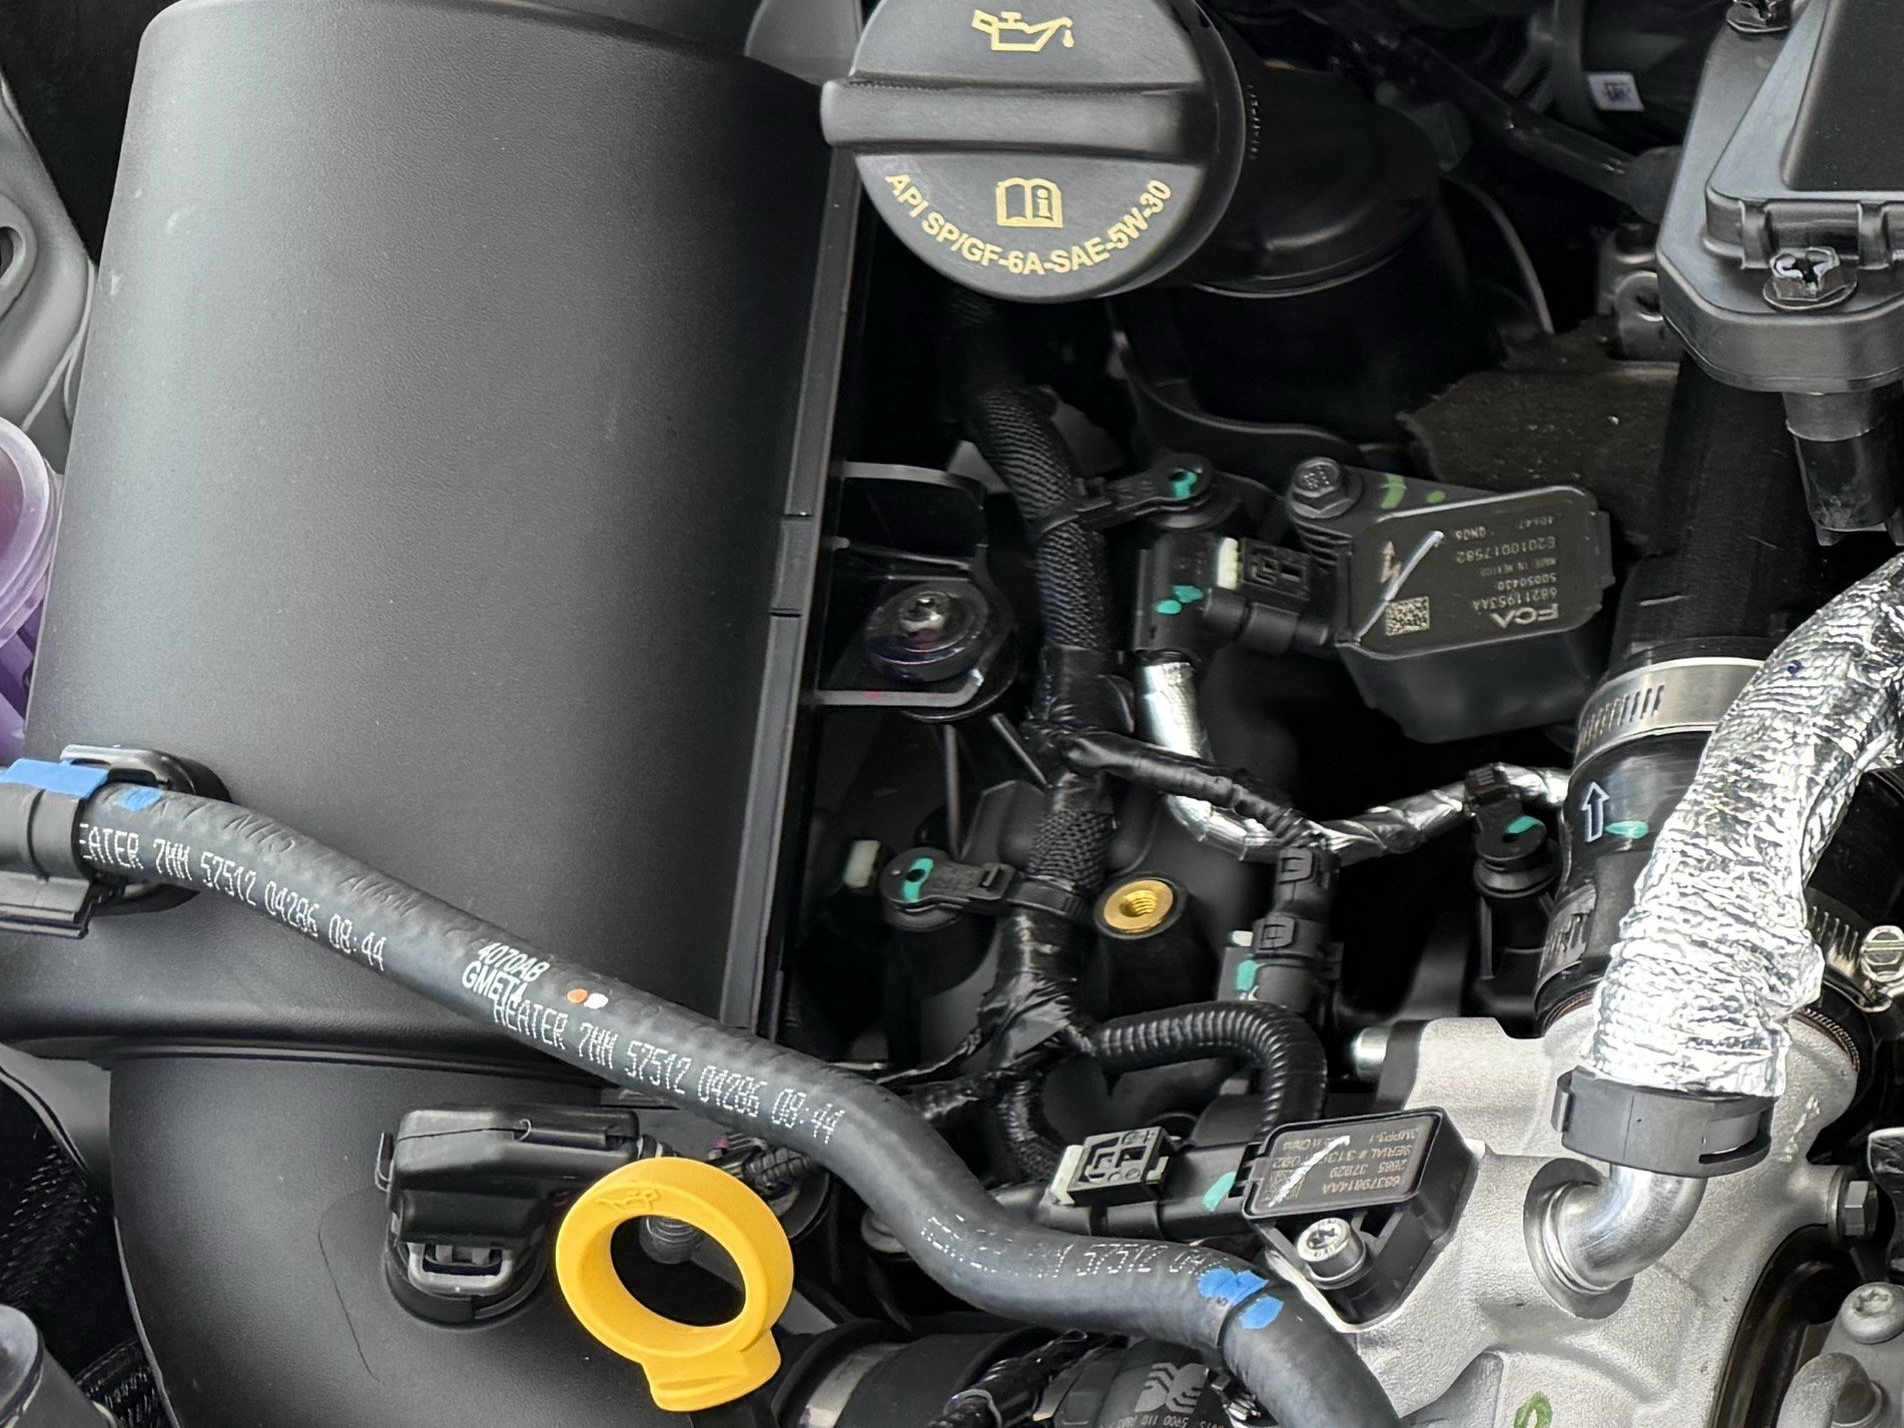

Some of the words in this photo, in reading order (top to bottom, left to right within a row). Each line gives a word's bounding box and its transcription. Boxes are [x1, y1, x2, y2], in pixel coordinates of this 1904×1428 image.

[884, 173, 923, 218] API
[1488, 602, 1558, 629] FCA
[200, 852, 257, 907] 57512
[263, 880, 320, 938] 04286
[327, 914, 388, 972] 08:44
[477, 942, 551, 983] 4070AB
[493, 997, 570, 1050] HEATER
[624, 1040, 692, 1095] 57512
[697, 1065, 768, 1118] 04286
[771, 1088, 846, 1145] 08:44
[1368, 1143, 1412, 1159] SERIAL
